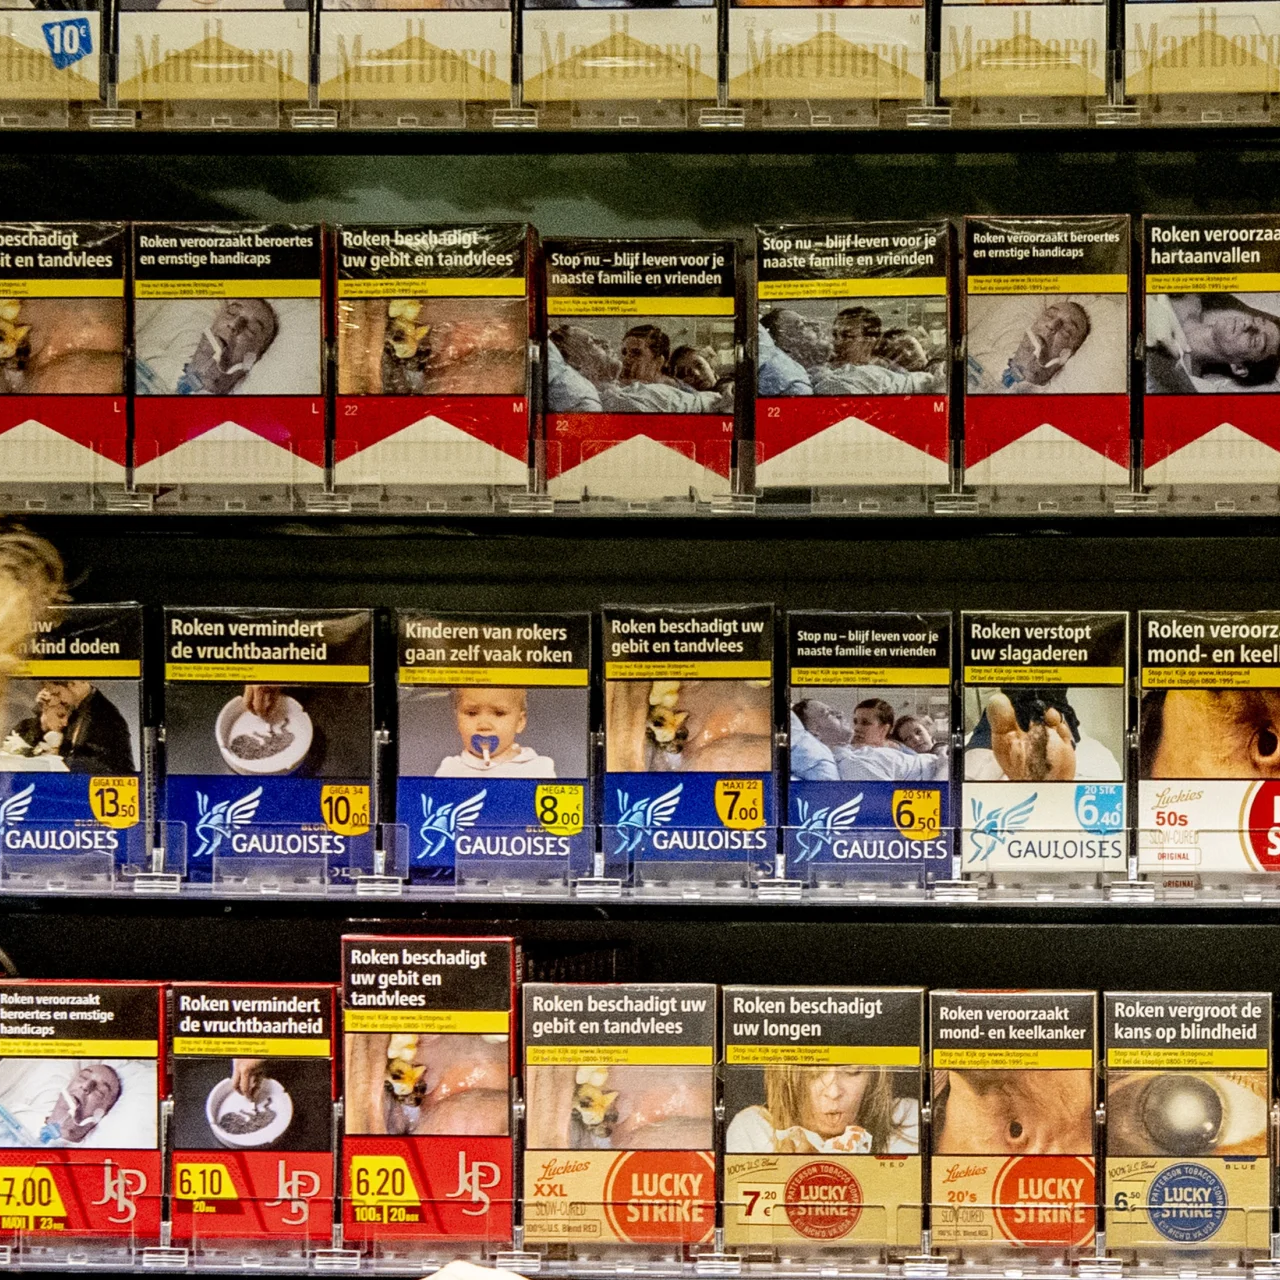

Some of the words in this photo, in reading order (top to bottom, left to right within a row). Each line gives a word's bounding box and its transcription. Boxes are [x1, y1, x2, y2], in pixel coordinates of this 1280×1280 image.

[343, 403, 358, 417] 22
[512, 402, 525, 414] M
[406, 622, 478, 639] Kinderen
[482, 627, 512, 639] van
[517, 624, 566, 640] rokers
[1149, 620, 1204, 638] Roken
[406, 642, 446, 664] gaan
[450, 645, 480, 661] zelf
[483, 645, 522, 662] vaak
[527, 646, 572, 662] roken
[1148, 644, 1207, 662] mond-
[1212, 649, 1234, 662] en
[541, 786, 566, 796] MEGA
[568, 786, 580, 796] 25
[1156, 811, 1189, 827] 50s
[455, 836, 570, 857] GAULOISES
[1007, 839, 1122, 861] GAULOISES
[1156, 852, 1191, 861] ORIGINAL
[352, 950, 398, 966] Roken
[402, 949, 487, 970] beschadigt
[352, 974, 375, 985] uw
[378, 970, 419, 989] gebit
[422, 974, 441, 985] en
[351, 990, 426, 1006] tandvlees
[178, 1168, 223, 1196] 6.10
[356, 1166, 406, 1196] 6.20
[2, 1176, 52, 1207] 7.00
[799, 1183, 848, 1201] LUCKY
[796, 1201, 849, 1217] STRIKE
